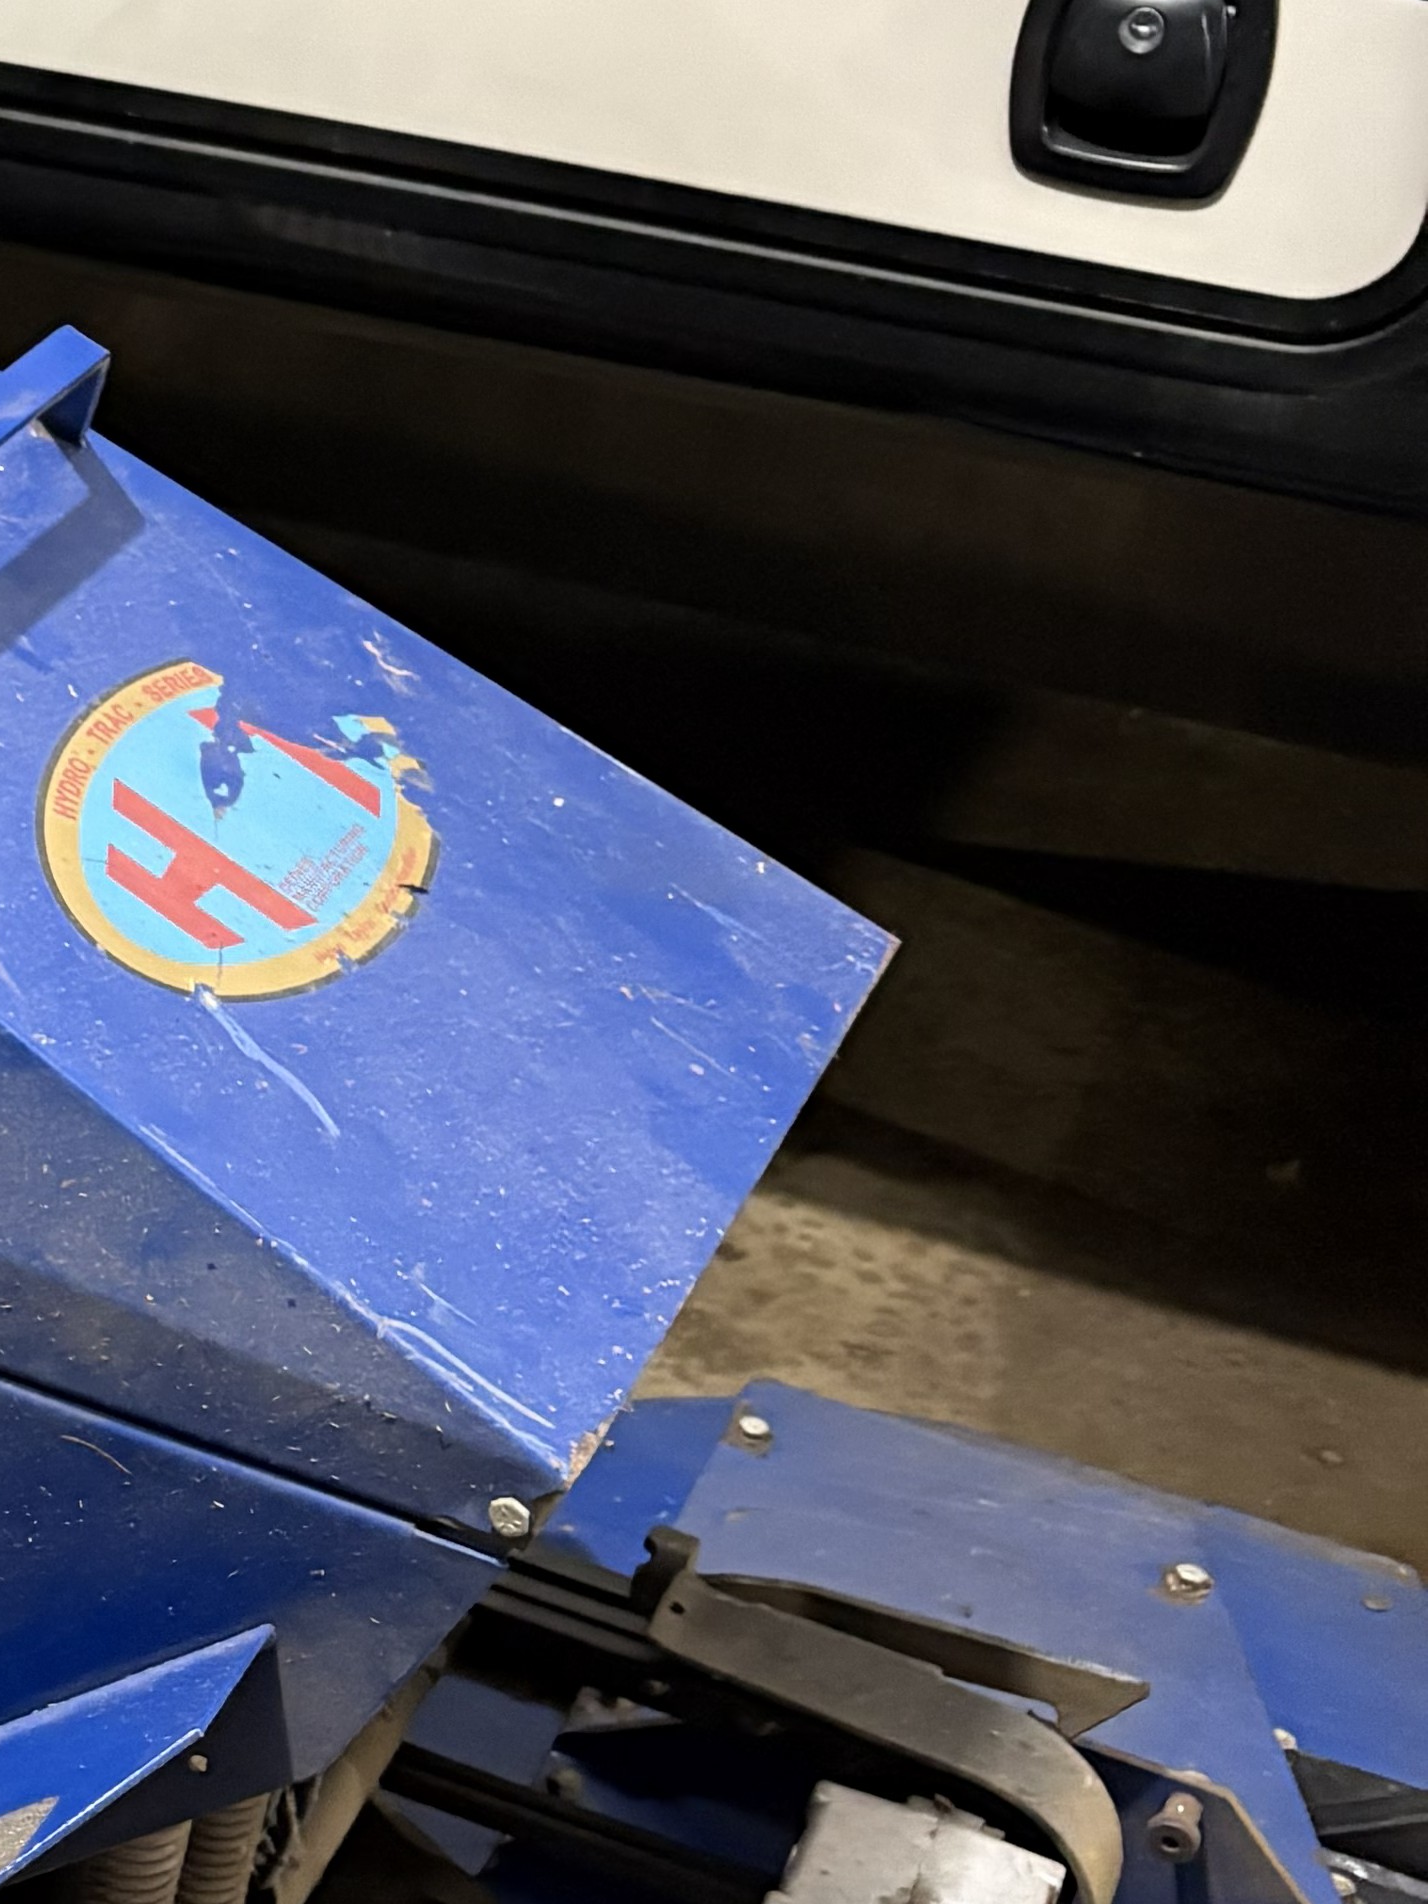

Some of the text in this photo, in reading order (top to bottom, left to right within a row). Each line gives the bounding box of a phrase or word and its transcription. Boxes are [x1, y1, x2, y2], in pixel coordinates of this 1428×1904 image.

[53, 666, 214, 820] HYDRO TRAC SERIES
